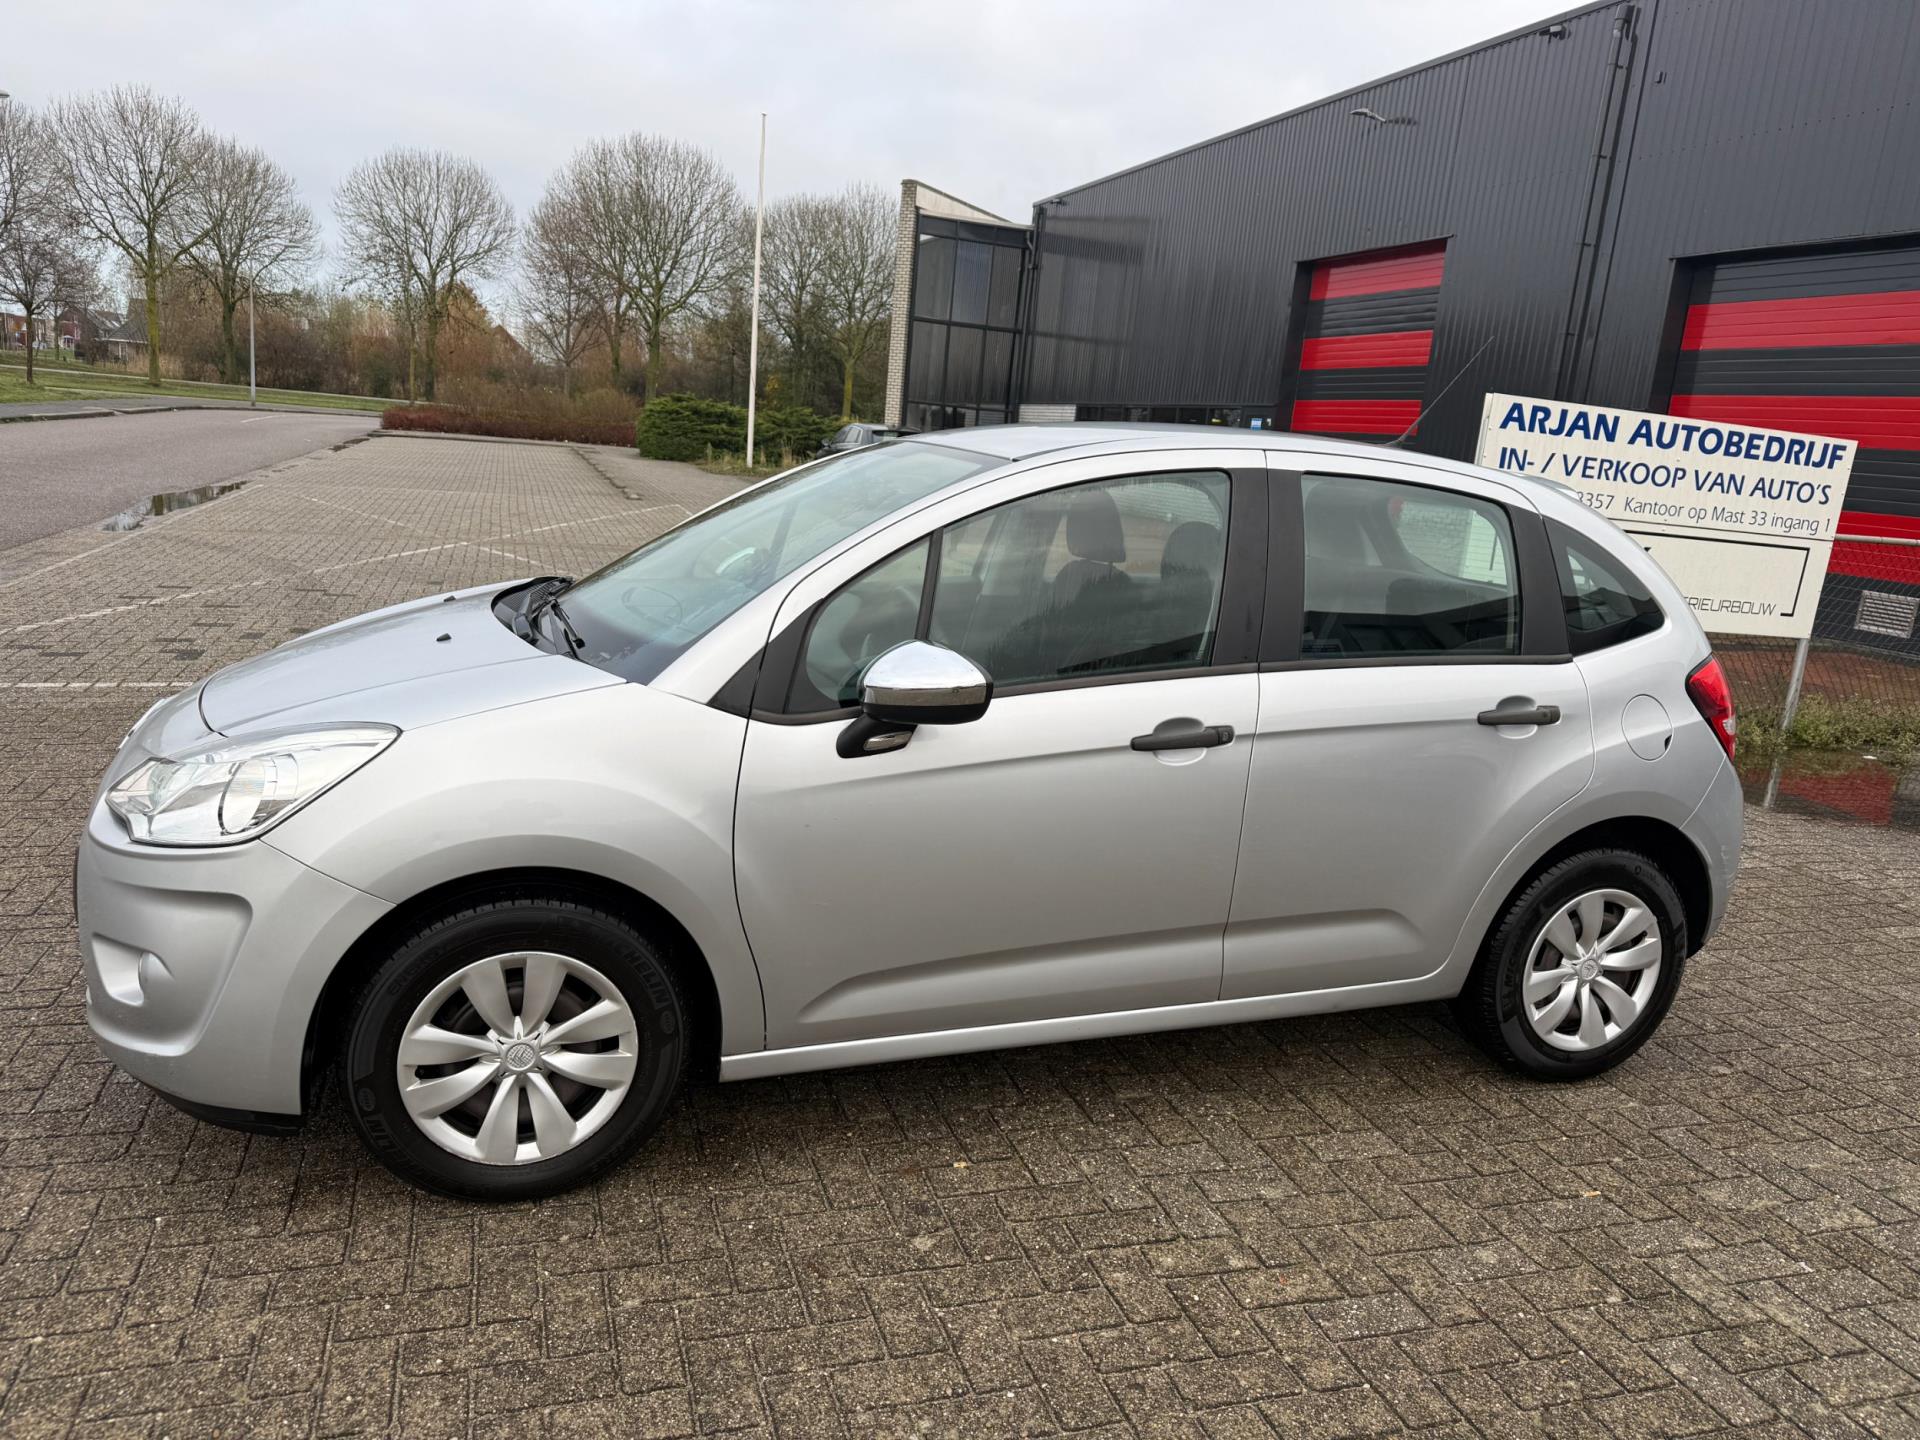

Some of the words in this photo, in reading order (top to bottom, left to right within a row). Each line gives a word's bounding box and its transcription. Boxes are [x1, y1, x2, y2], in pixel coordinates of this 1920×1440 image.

[1499, 402, 1621, 443] ARJAN
[1627, 419, 1848, 469] AUTOBEDRIJF
[1498, 446, 1535, 472] IN-
[1562, 454, 1687, 489] VERKOOP
[1694, 469, 1746, 496] VAN
[1749, 477, 1832, 505] AUTO'S
[1624, 496, 1684, 517] Kantoor
[1687, 506, 1707, 523] op
[1711, 506, 1746, 524] Mast
[1748, 510, 1768, 526] 33
[1771, 512, 1820, 535] ingang
[1824, 518, 1831, 533] 1
